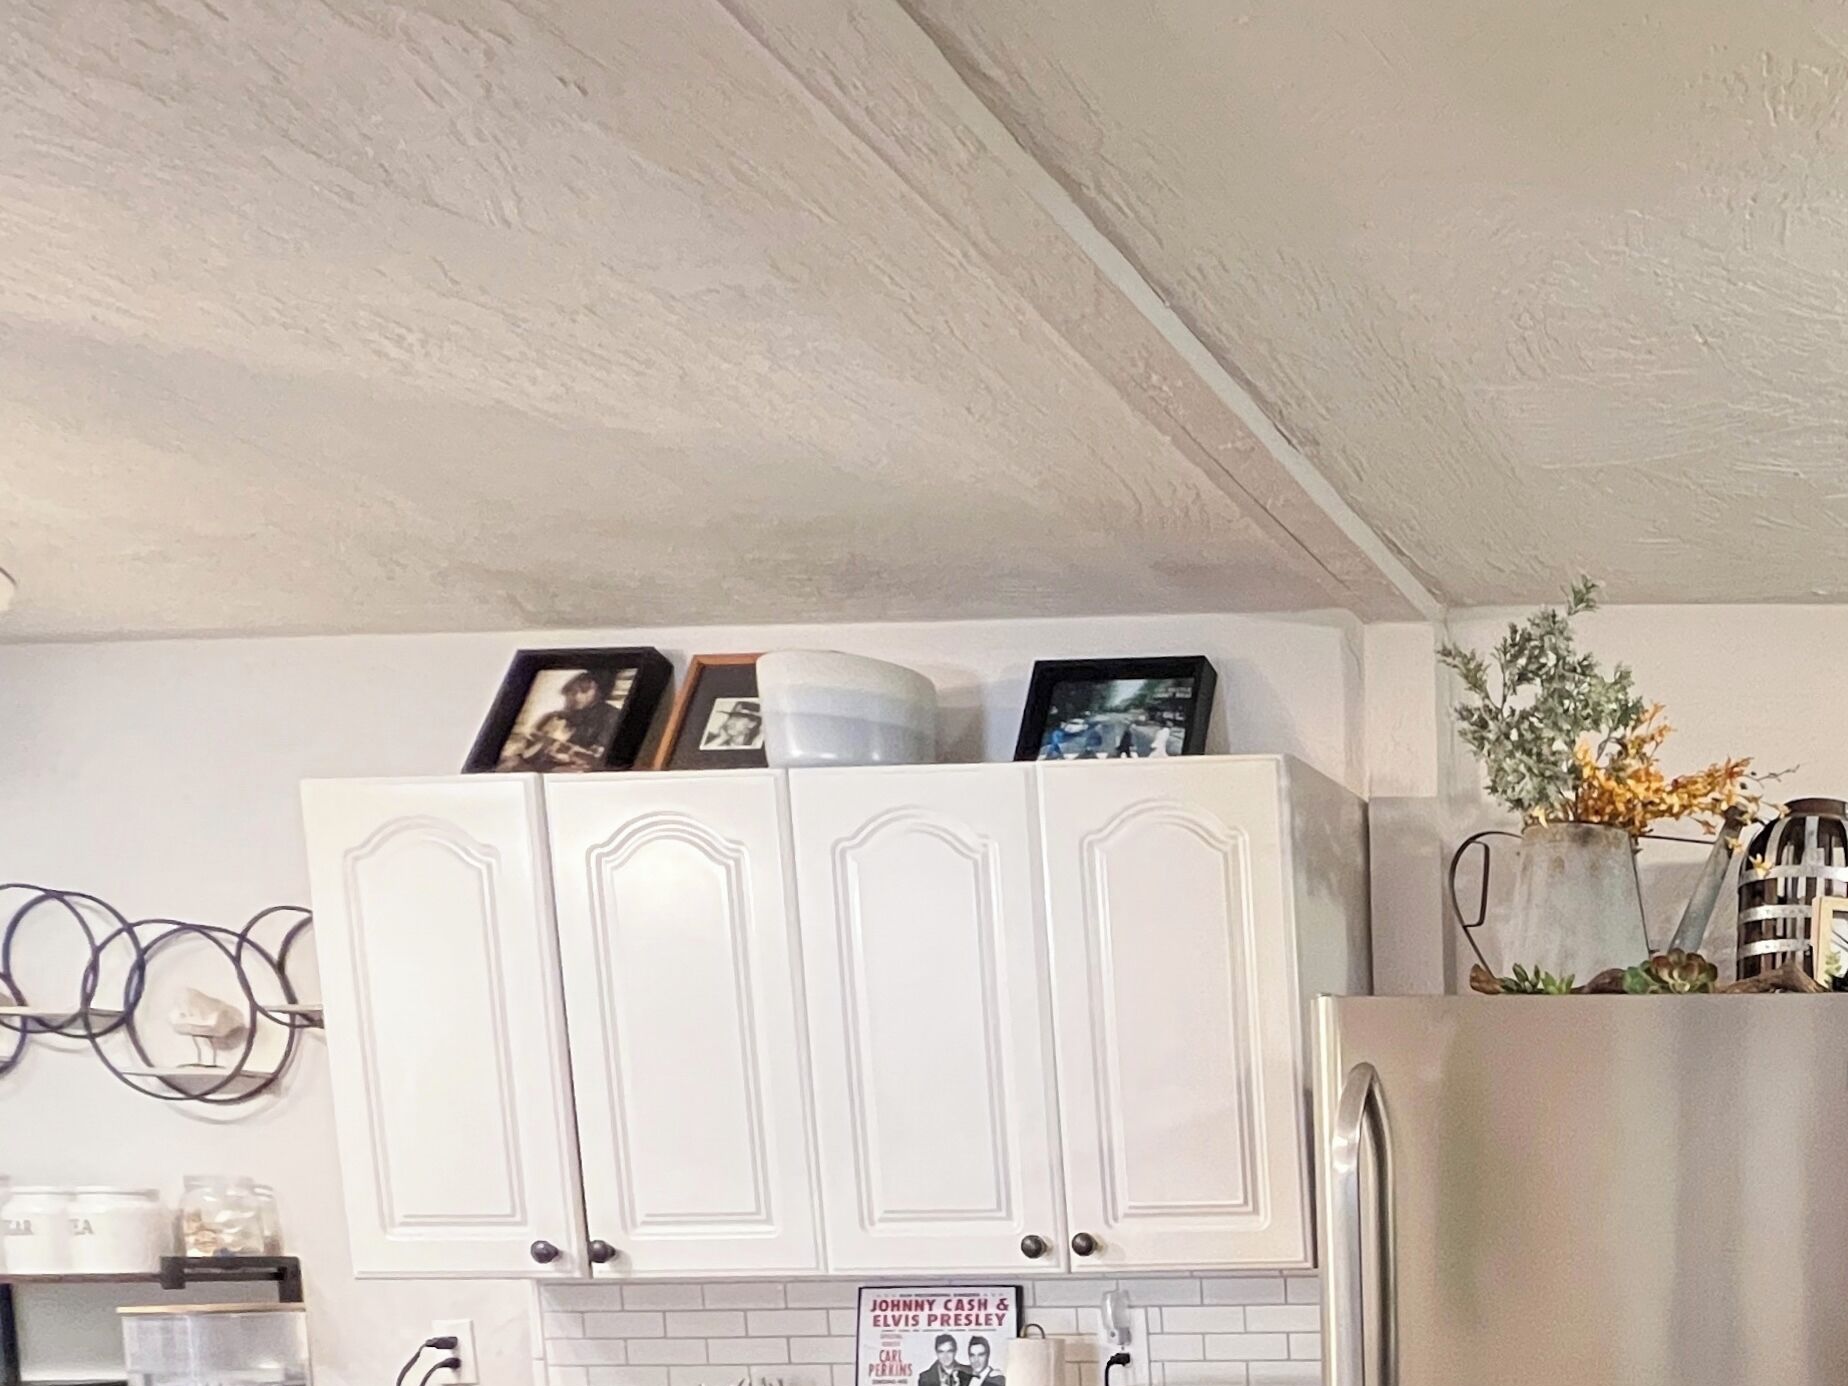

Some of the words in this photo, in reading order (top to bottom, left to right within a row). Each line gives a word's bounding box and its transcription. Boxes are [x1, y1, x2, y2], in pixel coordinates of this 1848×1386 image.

[870, 1299, 936, 1312] JOHNNY
[943, 1299, 988, 1312] CASH
[996, 1297, 1009, 1311] &
[873, 1314, 920, 1327] ELVIS
[927, 1313, 1006, 1327] PRESLEY
[879, 1349, 902, 1362] CARL
[868, 1363, 913, 1377] PERKINS
